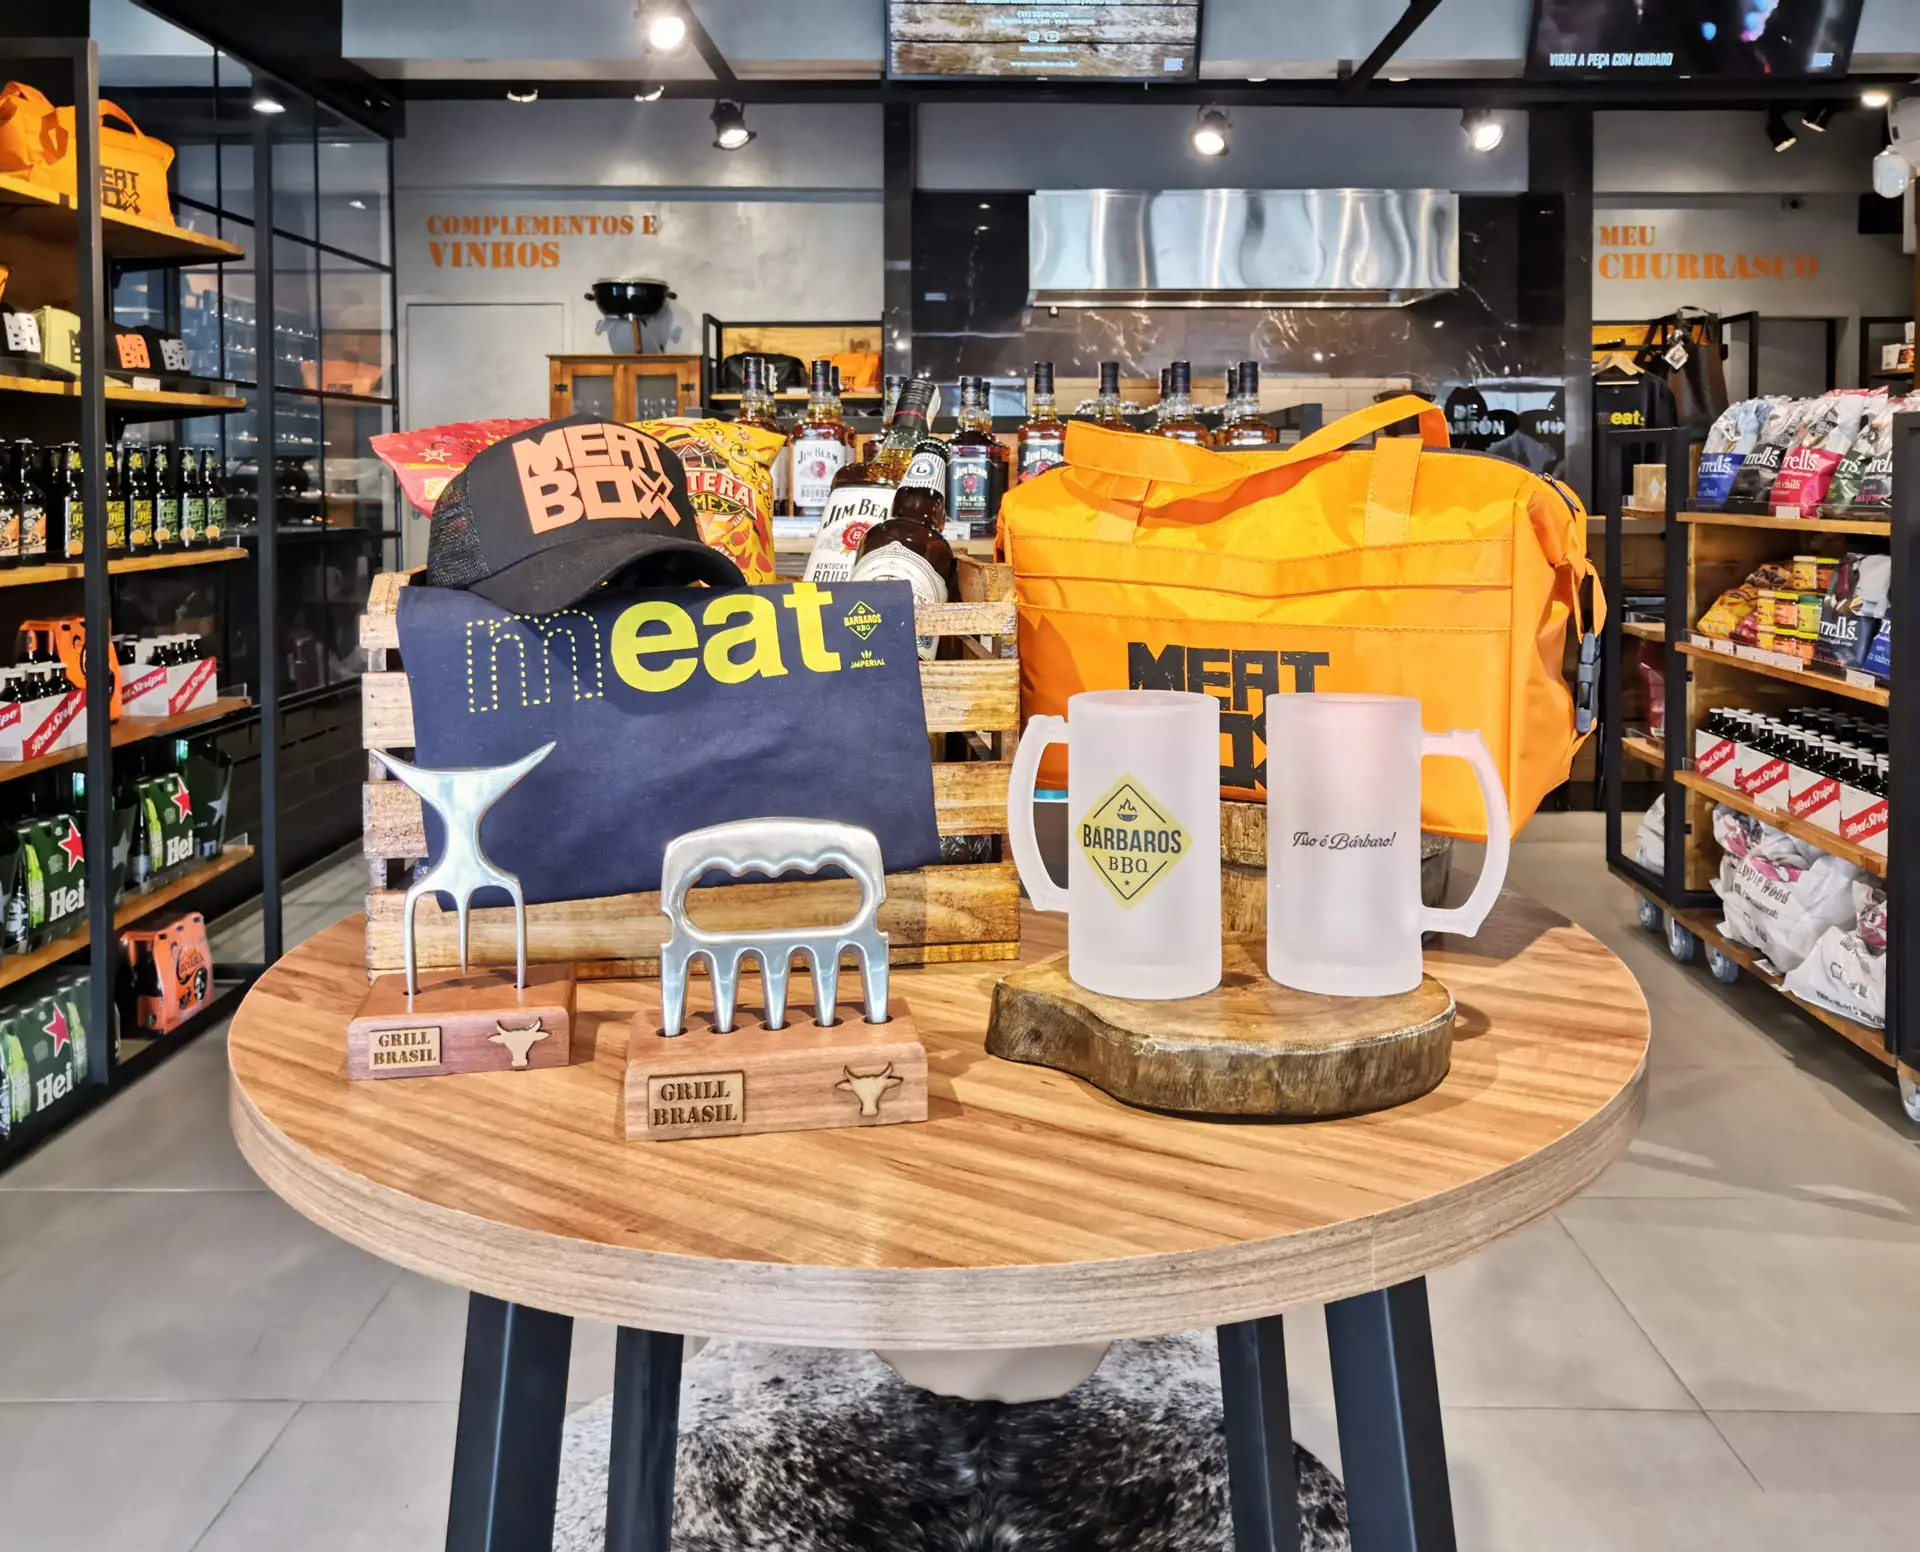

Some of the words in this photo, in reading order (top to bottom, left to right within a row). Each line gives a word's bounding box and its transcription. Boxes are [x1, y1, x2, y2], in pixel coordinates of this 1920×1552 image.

[1549, 53, 1576, 66] VIRAR
[1577, 53, 1585, 66] A
[100, 165, 139, 191] EAT
[427, 215, 634, 235] COMPLEMENTOS
[642, 215, 658, 235] E
[1599, 226, 1656, 246] MEU
[428, 241, 561, 268] VINHOS
[1598, 253, 1819, 280] CHURRASCO
[512, 423, 661, 477] MEAT
[686, 470, 749, 507] TERA
[521, 464, 682, 535] BOX
[694, 494, 730, 514] MEX
[823, 503, 856, 529] JIM
[858, 498, 890, 521] BEA
[813, 571, 849, 581] BOUR
[816, 563, 850, 571] KENTUCKY
[850, 658, 886, 669] IMPERIAL
[1127, 642, 1330, 711] MEAT
[1866, 807, 1888, 829] Strip
[1319, 834, 1329, 847] é
[1108, 856, 1149, 874] BBQ
[377, 1032, 431, 1048] GRILL
[373, 1048, 437, 1067] BRASIL
[660, 1080, 731, 1102] GRILL
[653, 1103, 739, 1127] BRASIL
